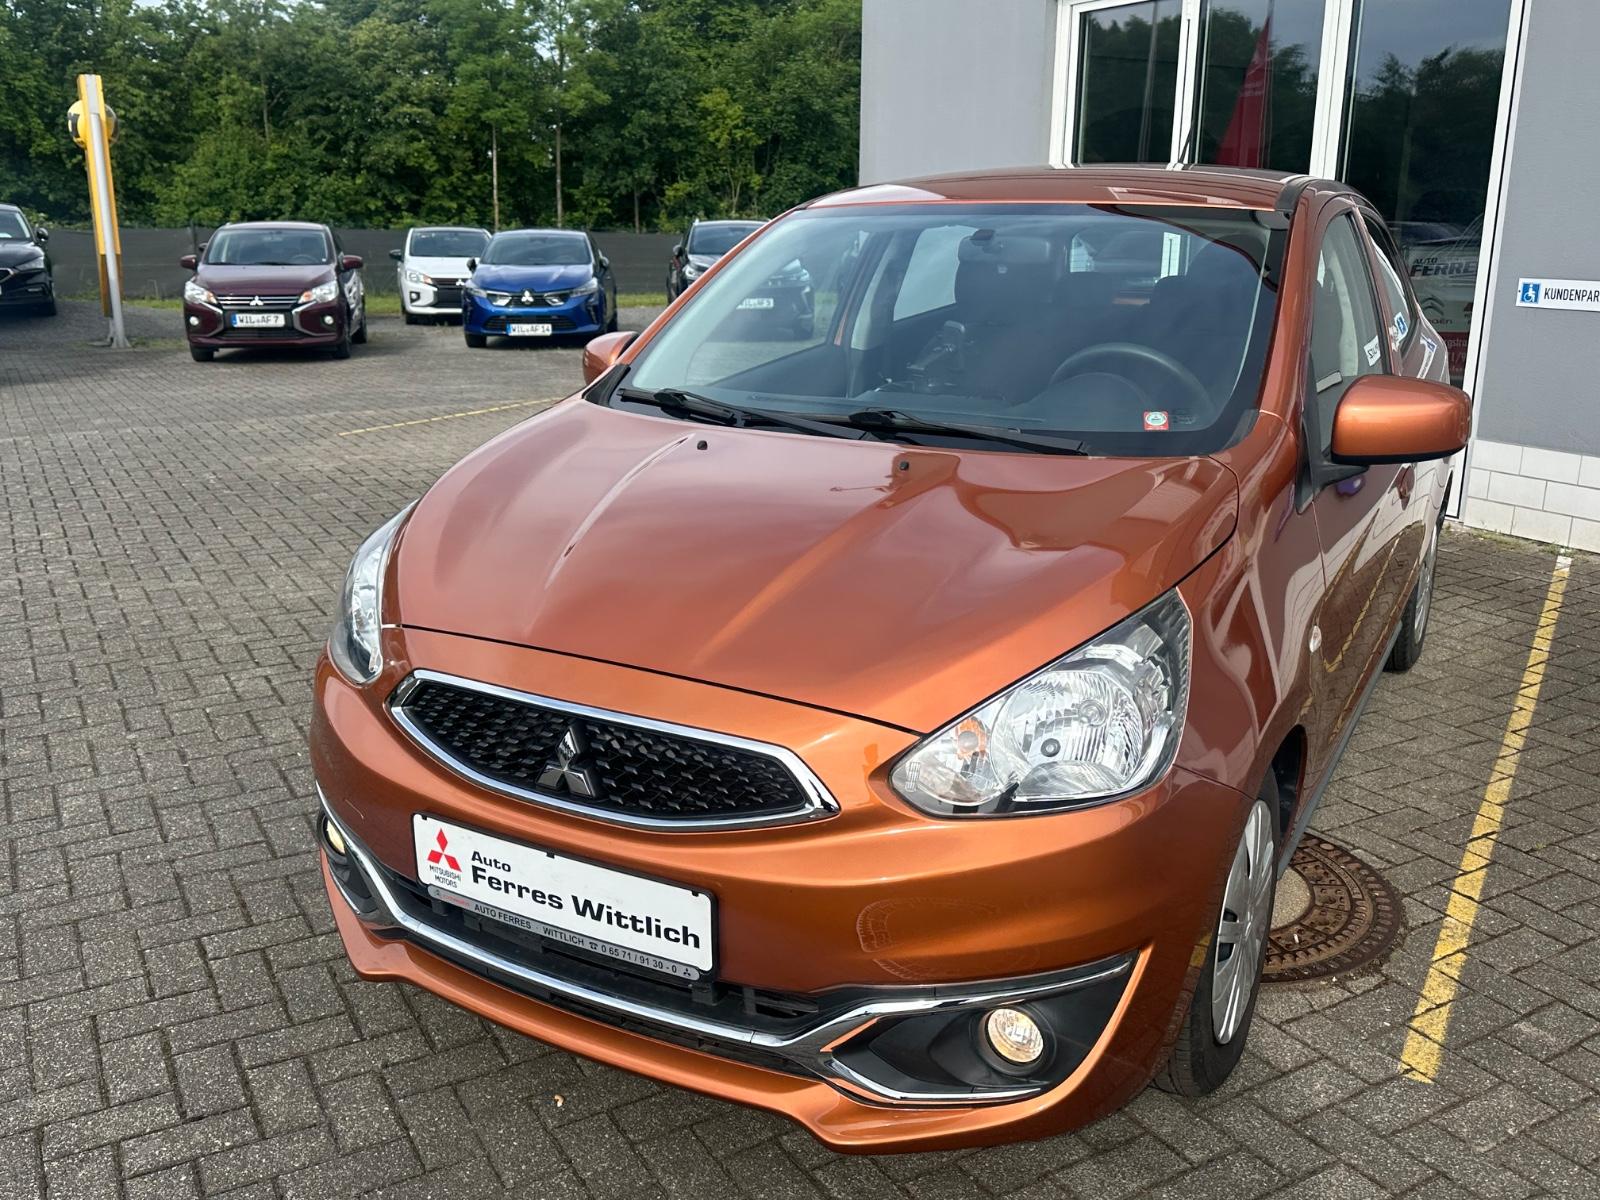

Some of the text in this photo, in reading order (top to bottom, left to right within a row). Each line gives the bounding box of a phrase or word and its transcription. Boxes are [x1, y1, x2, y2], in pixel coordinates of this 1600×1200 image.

[471, 850, 511, 872] Auto
[429, 864, 461, 882] MITSUBISHI
[435, 875, 458, 889] MOTORS
[471, 865, 700, 949] Ferres Wittlich
[474, 903, 497, 918] AUTO
[499, 912, 531, 930] FERRES
[543, 926, 584, 946] WITTLICH
